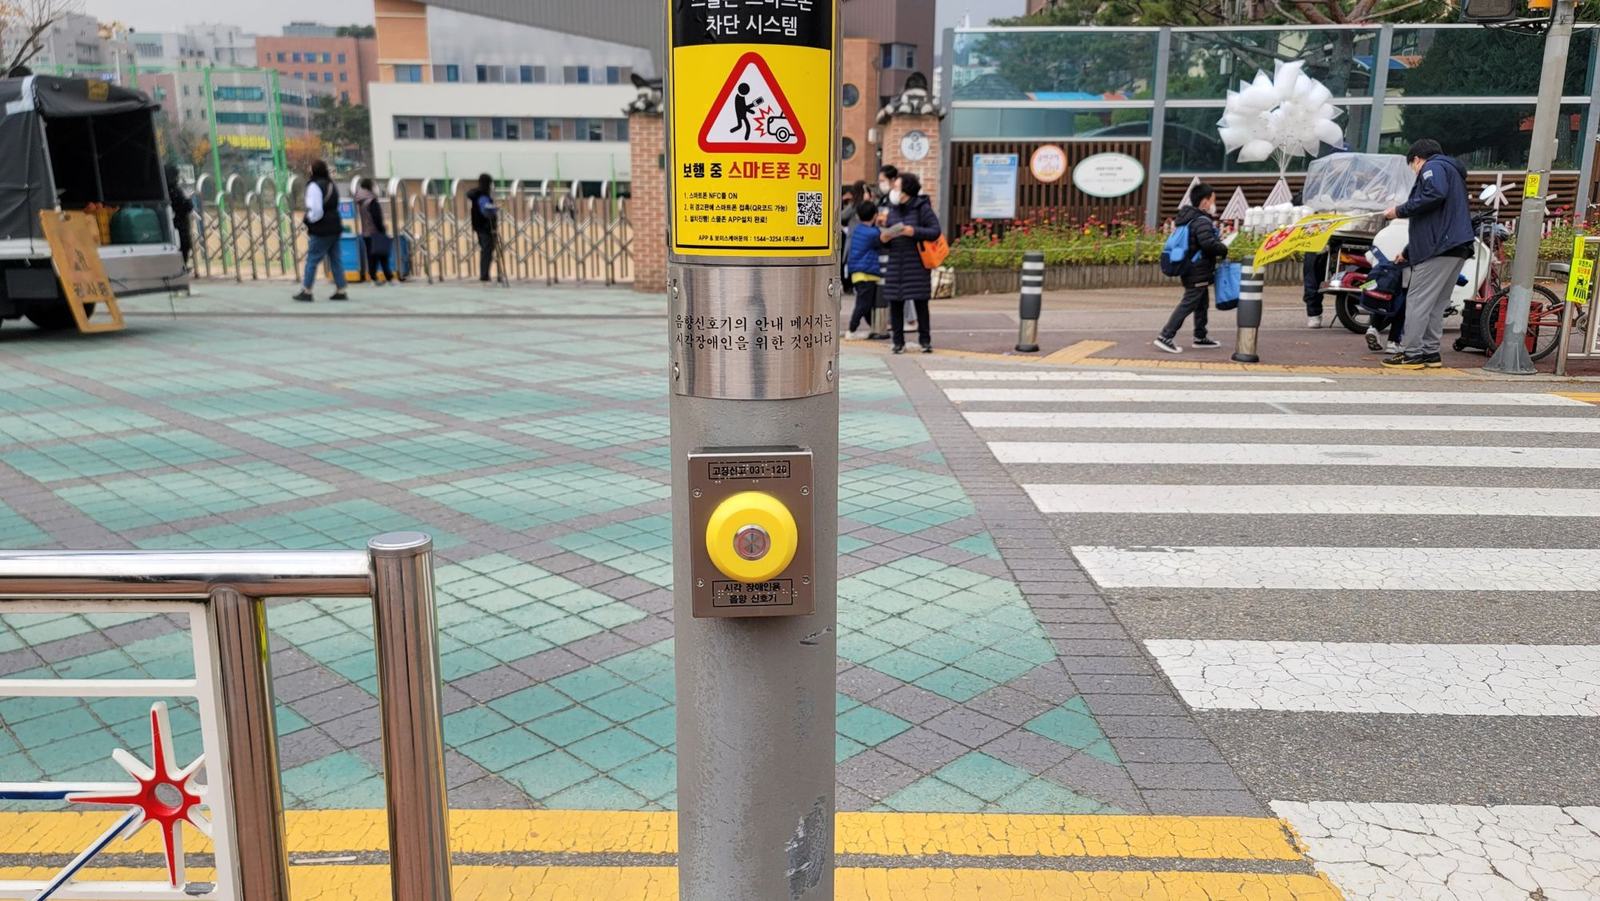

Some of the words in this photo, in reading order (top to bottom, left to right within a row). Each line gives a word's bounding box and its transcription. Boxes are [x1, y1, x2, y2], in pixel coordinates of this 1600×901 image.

[706, 14, 740, 35] 차단
[746, 14, 798, 36] 시스템
[683, 162, 705, 178] 보행
[710, 162, 722, 178] 중
[728, 161, 790, 179] 스마트폰
[797, 162, 821, 180] 주의
[675, 314, 747, 332] 음향신호기의
[755, 316, 784, 332] 안내
[790, 313, 833, 330] 메시지는
[675, 333, 749, 351] 시각장애인을
[755, 335, 784, 351] 위한
[791, 331, 833, 350] 것입니다
[712, 466, 747, 477] 고장신고
[749, 465, 787, 476] 031-120
[724, 582, 742, 593] 시각
[751, 593, 777, 605] 신호기
